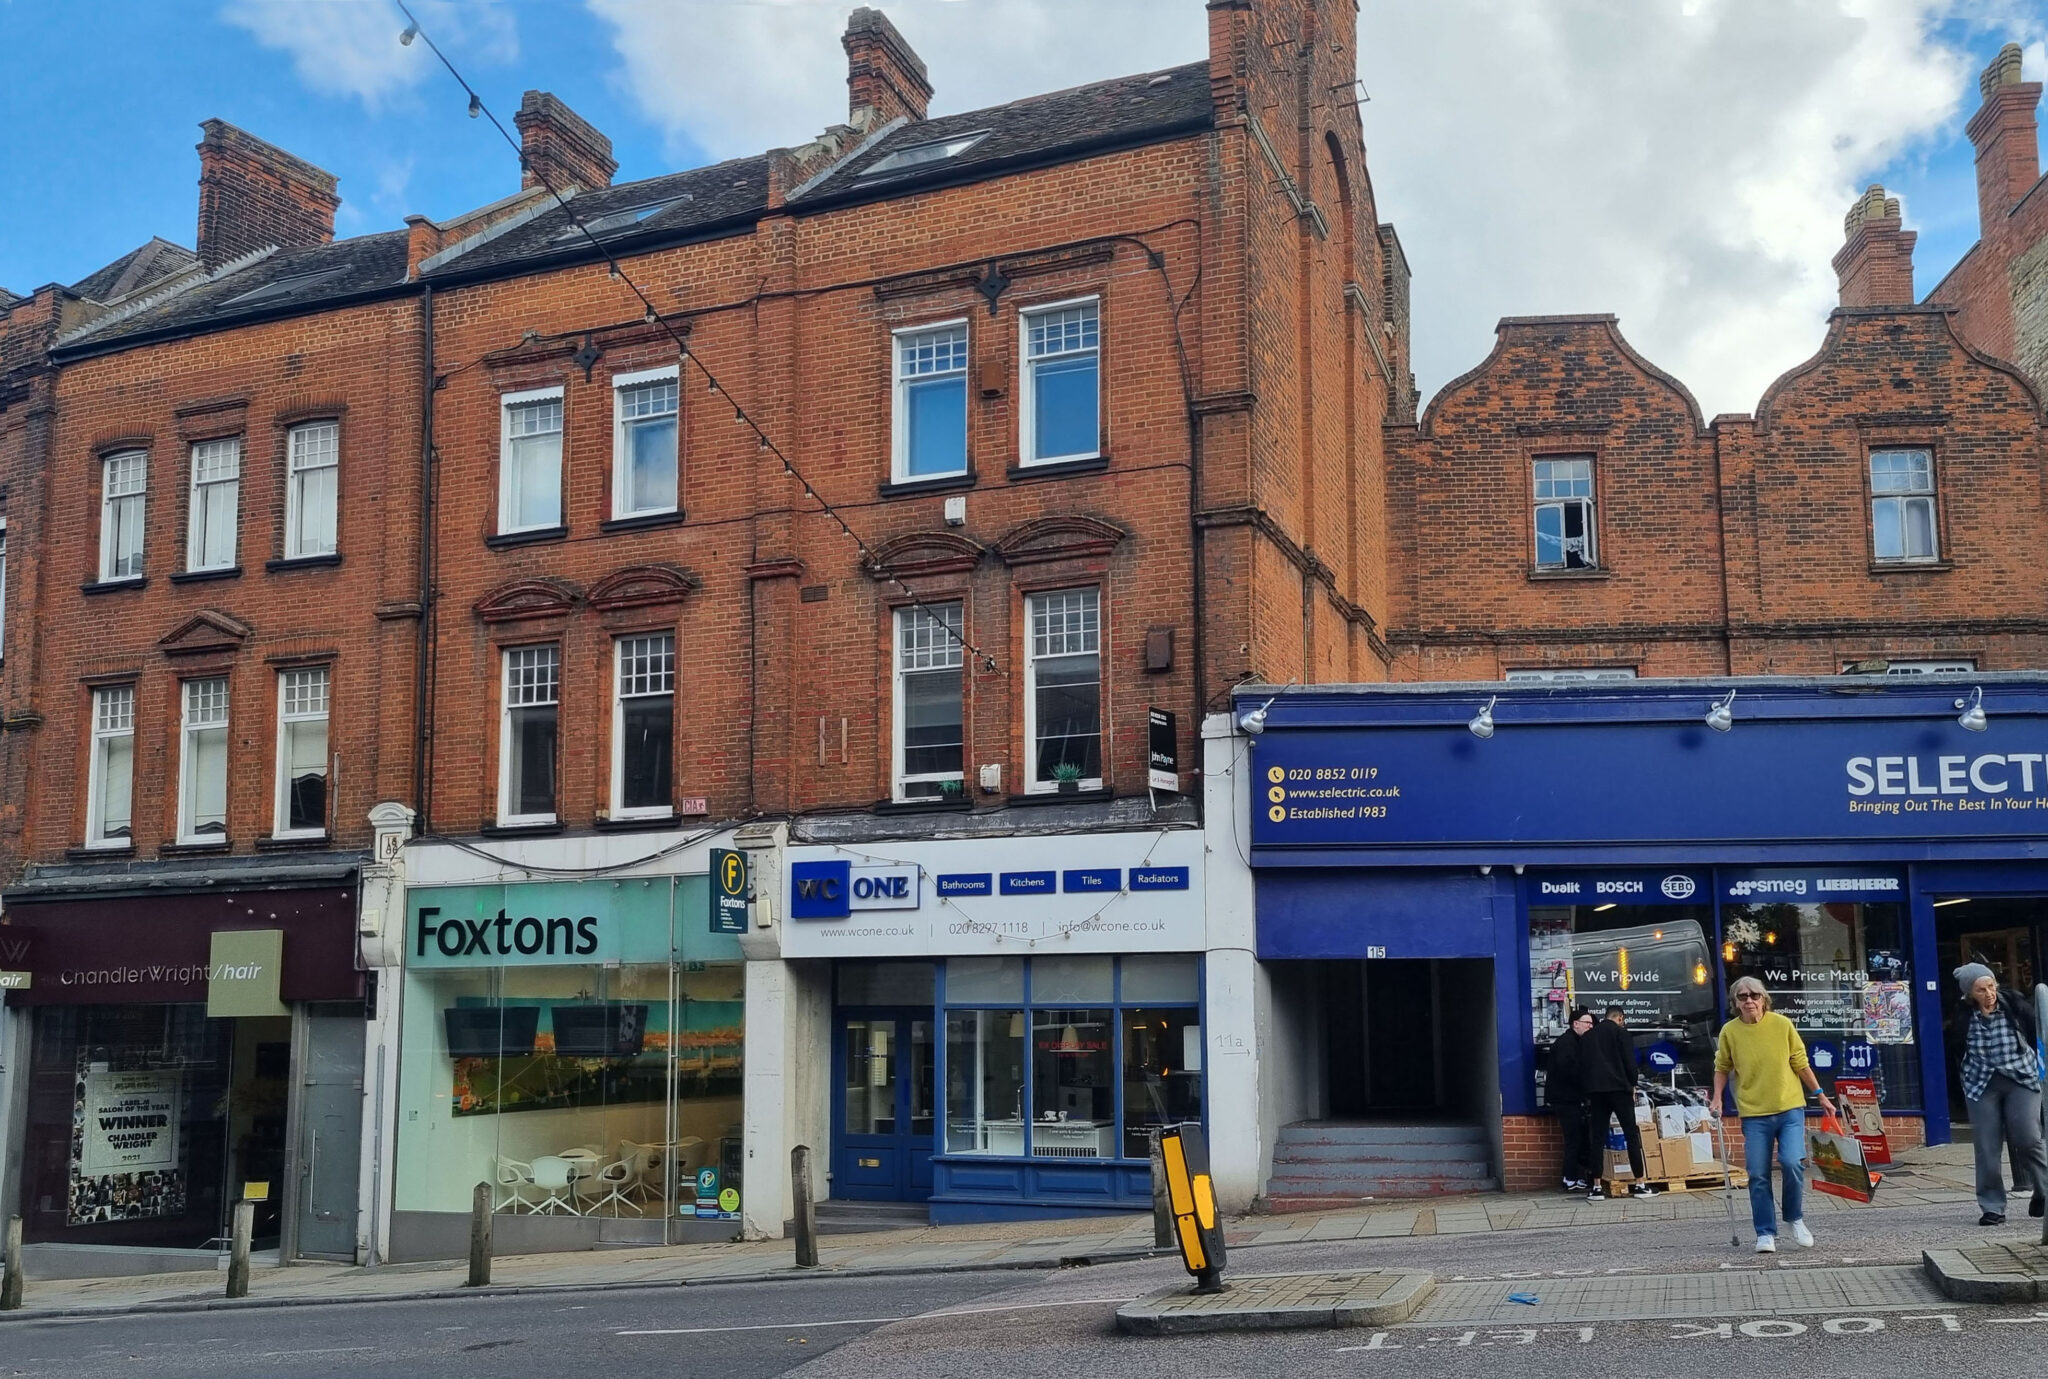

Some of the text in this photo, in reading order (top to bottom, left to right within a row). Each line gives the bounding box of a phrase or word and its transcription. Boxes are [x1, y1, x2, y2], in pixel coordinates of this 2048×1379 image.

[1289, 767, 1378, 780] 020 8852 0119
[1846, 753, 2048, 795] SELECT
[1289, 785, 1401, 798] www.selectric.co.uk
[1849, 797, 2048, 814] Bringing Out The Best In Your H
[1290, 806, 1387, 819] Established 1983
[942, 880, 986, 890] Bathrooms
[1010, 878, 1045, 888] Kitchens
[1081, 875, 1102, 885] Tiles
[1138, 874, 1179, 884] Radiators
[1816, 877, 1899, 891] LIEBHERR
[797, 875, 910, 900] WC ONE
[1541, 881, 1580, 894] Dualit
[1596, 881, 1643, 893] BOSCH
[1663, 882, 1693, 892] SEBO
[1756, 879, 1806, 895] smeg
[720, 895, 746, 909] Foxtons
[417, 906, 598, 956] Foxtons
[820, 924, 914, 937] www.wcone.co.uk
[949, 922, 1028, 935] 020 8297 1118
[1058, 919, 1165, 933] info@wcone.co.uk
[1370, 947, 1384, 958] 15
[0, 974, 22, 987] air
[1584, 969, 1660, 982] We Provide
[1765, 969, 1869, 981] We Price Match
[1830, 1007, 1846, 1015] High
[98, 1106, 123, 1114] SALON
[98, 1114, 168, 1131] WINNER
[107, 1131, 158, 1142] CHANDLER
[112, 1140, 153, 1150] WRIGHT
